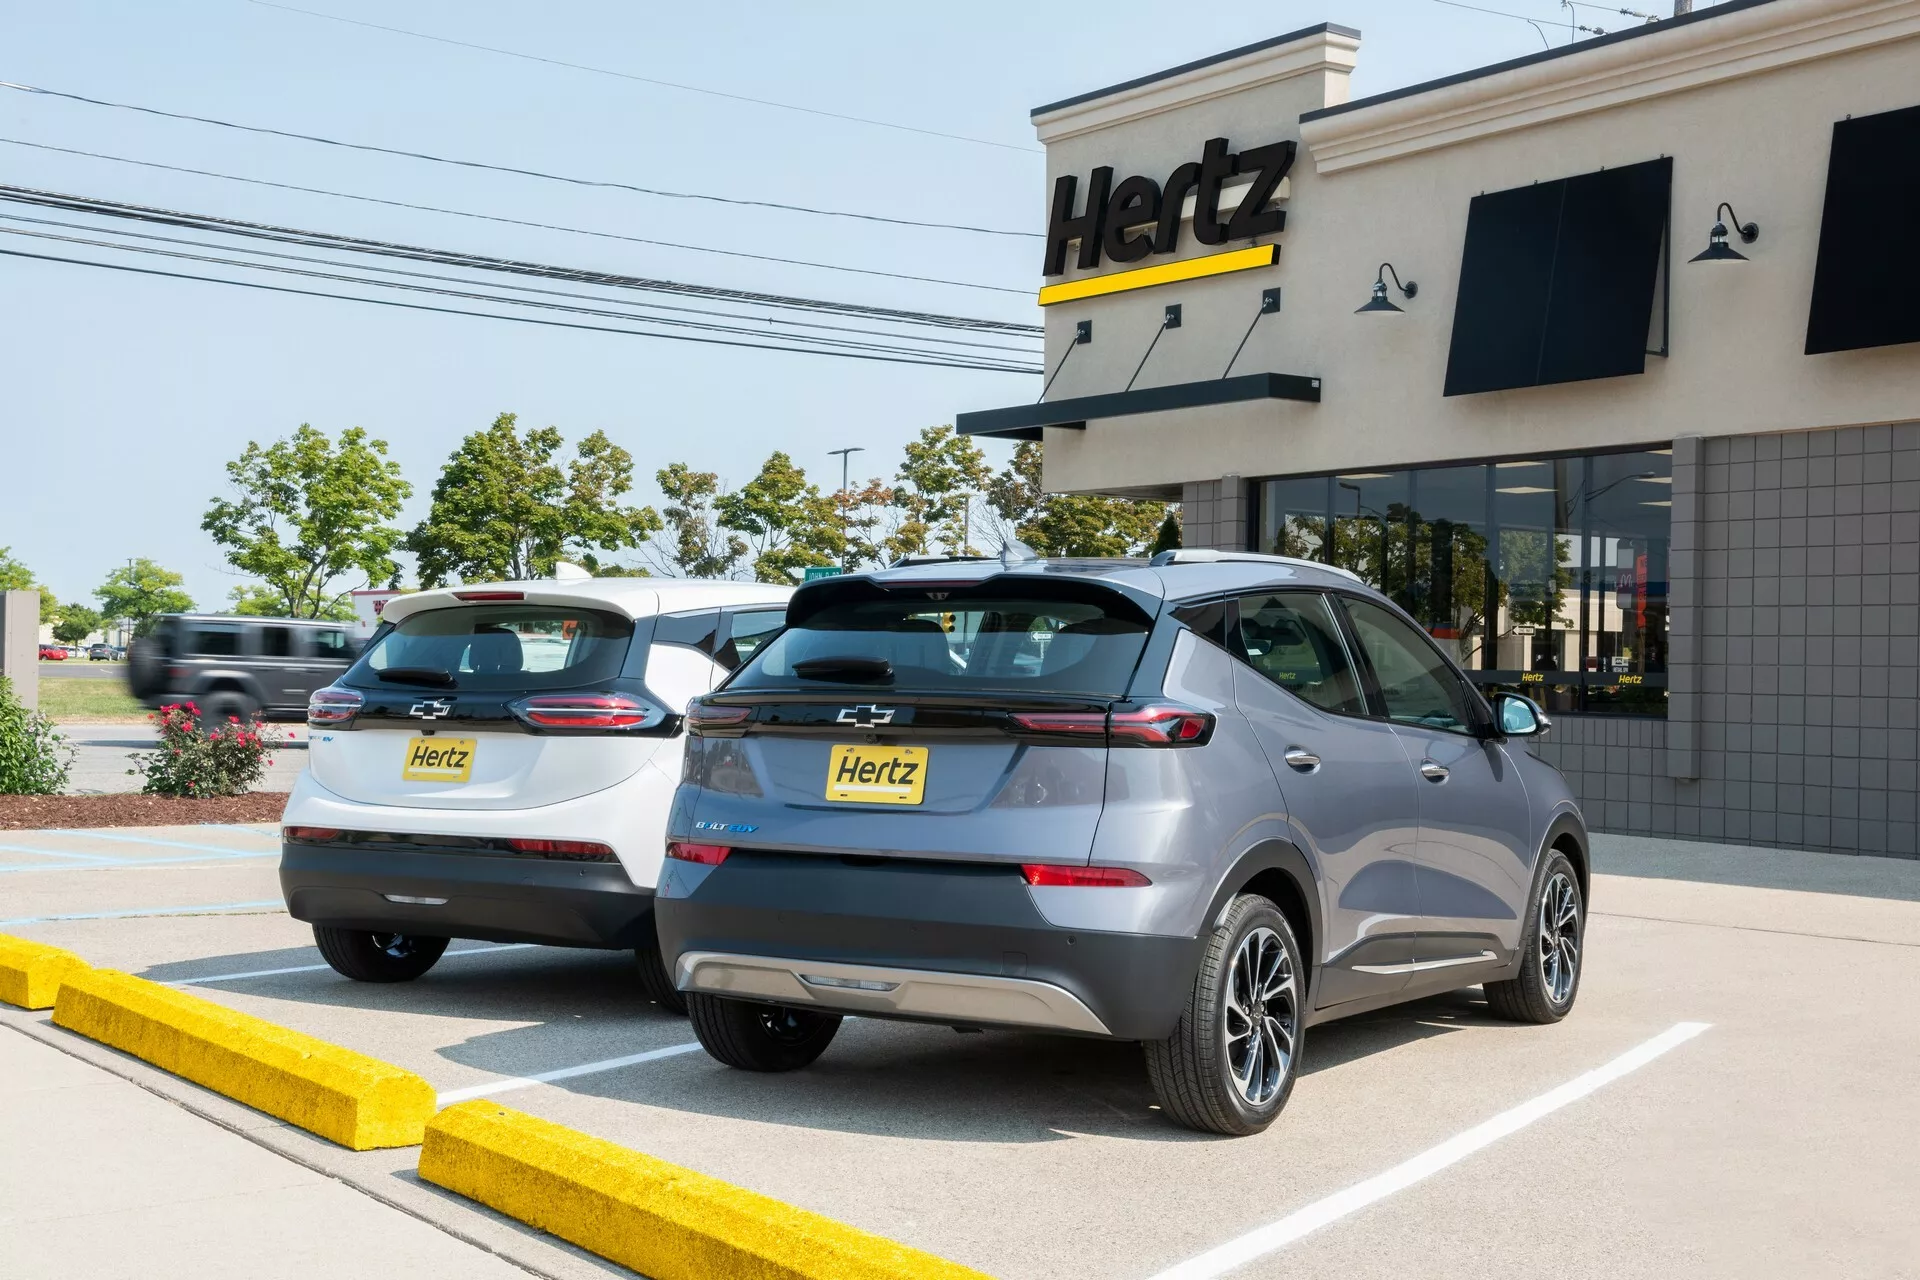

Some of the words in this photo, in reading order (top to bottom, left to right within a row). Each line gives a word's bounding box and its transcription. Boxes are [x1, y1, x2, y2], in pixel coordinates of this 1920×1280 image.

[1043, 137, 1297, 276] Hertz
[1522, 672, 1544, 682] Hertz
[1618, 675, 1642, 684] Hertz
[410, 746, 469, 768] Hertz
[835, 756, 919, 785] Hertz
